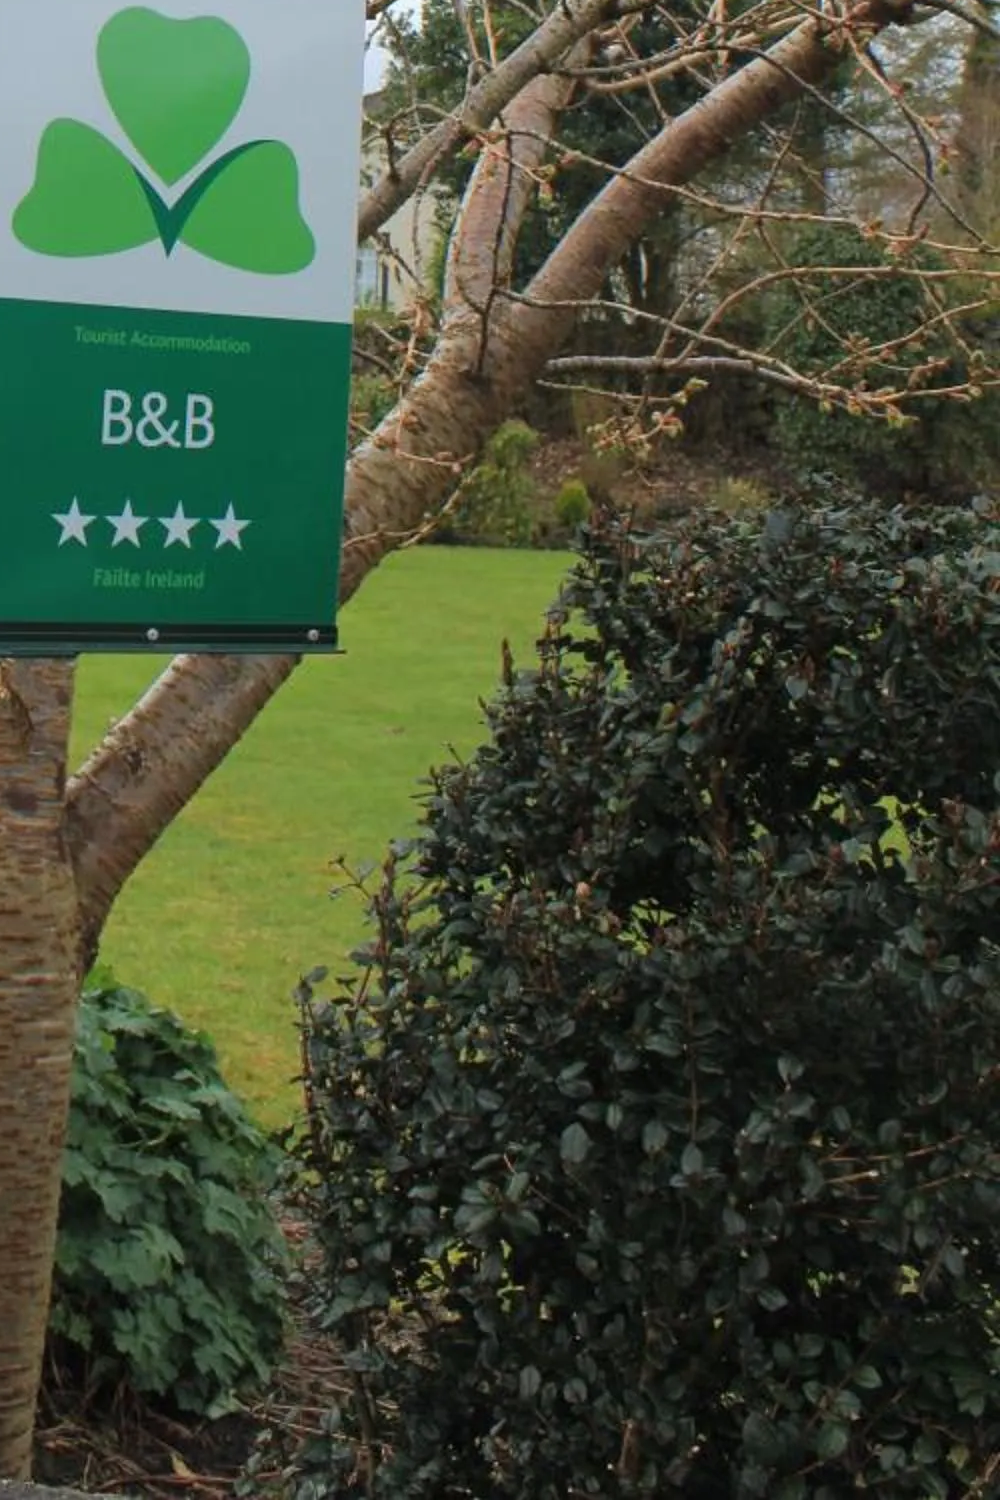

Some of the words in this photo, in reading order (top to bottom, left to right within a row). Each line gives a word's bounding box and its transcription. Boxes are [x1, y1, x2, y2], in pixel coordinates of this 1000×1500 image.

[74, 325, 127, 346] Tourist
[130, 329, 251, 354] Accommodation
[101, 389, 216, 449] B&B
[145, 568, 205, 589] Ireland
